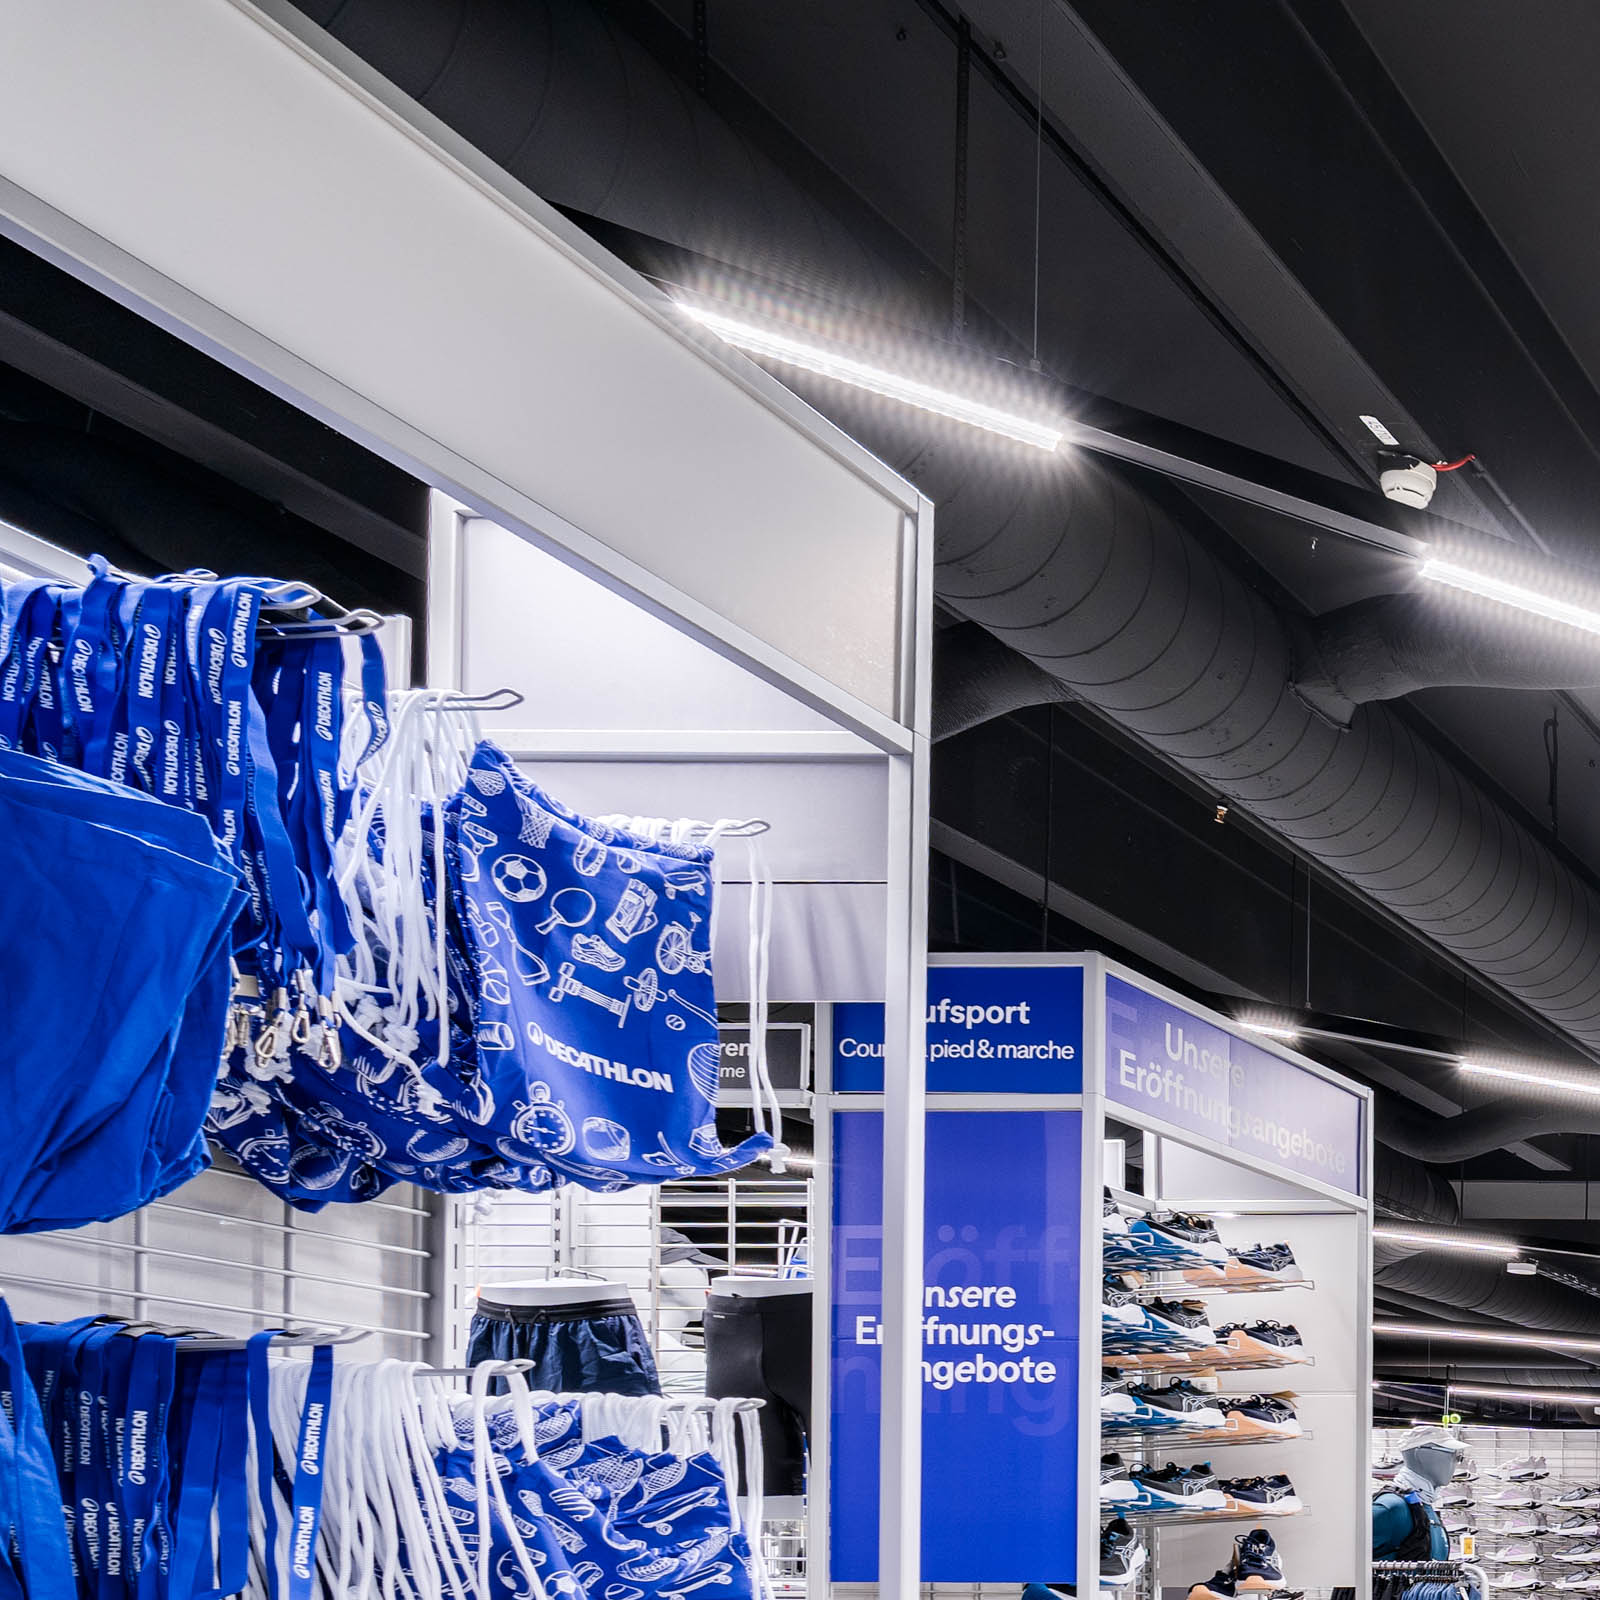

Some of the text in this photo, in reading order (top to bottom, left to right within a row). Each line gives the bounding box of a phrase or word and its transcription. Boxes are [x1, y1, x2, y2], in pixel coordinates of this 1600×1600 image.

[232, 592, 253, 653] DECATHLON
[138, 638, 160, 698] DECATHLON
[208, 644, 225, 705] DECATHLON
[317, 672, 333, 727] DECATHLON
[111, 733, 128, 784] CATHLON
[227, 701, 242, 761] DECATHLON
[164, 735, 180, 796] DECATHLON
[925, 999, 1030, 1029] ufsport
[544, 1033, 674, 1093] DECATHLON
[930, 1039, 1075, 1065] pied & marche
[1165, 1022, 1245, 1089] Unsere
[1119, 1049, 1345, 1174] Eröffnungsangebote
[924, 1284, 1017, 1309] nsere
[922, 1353, 1057, 1391] ngebote
[80, 1405, 91, 1465] DECATHLON
[133, 1410, 148, 1471] DECATHLON
[304, 1403, 323, 1463] DECATHLON
[297, 1506, 314, 1565] DECATHLON
